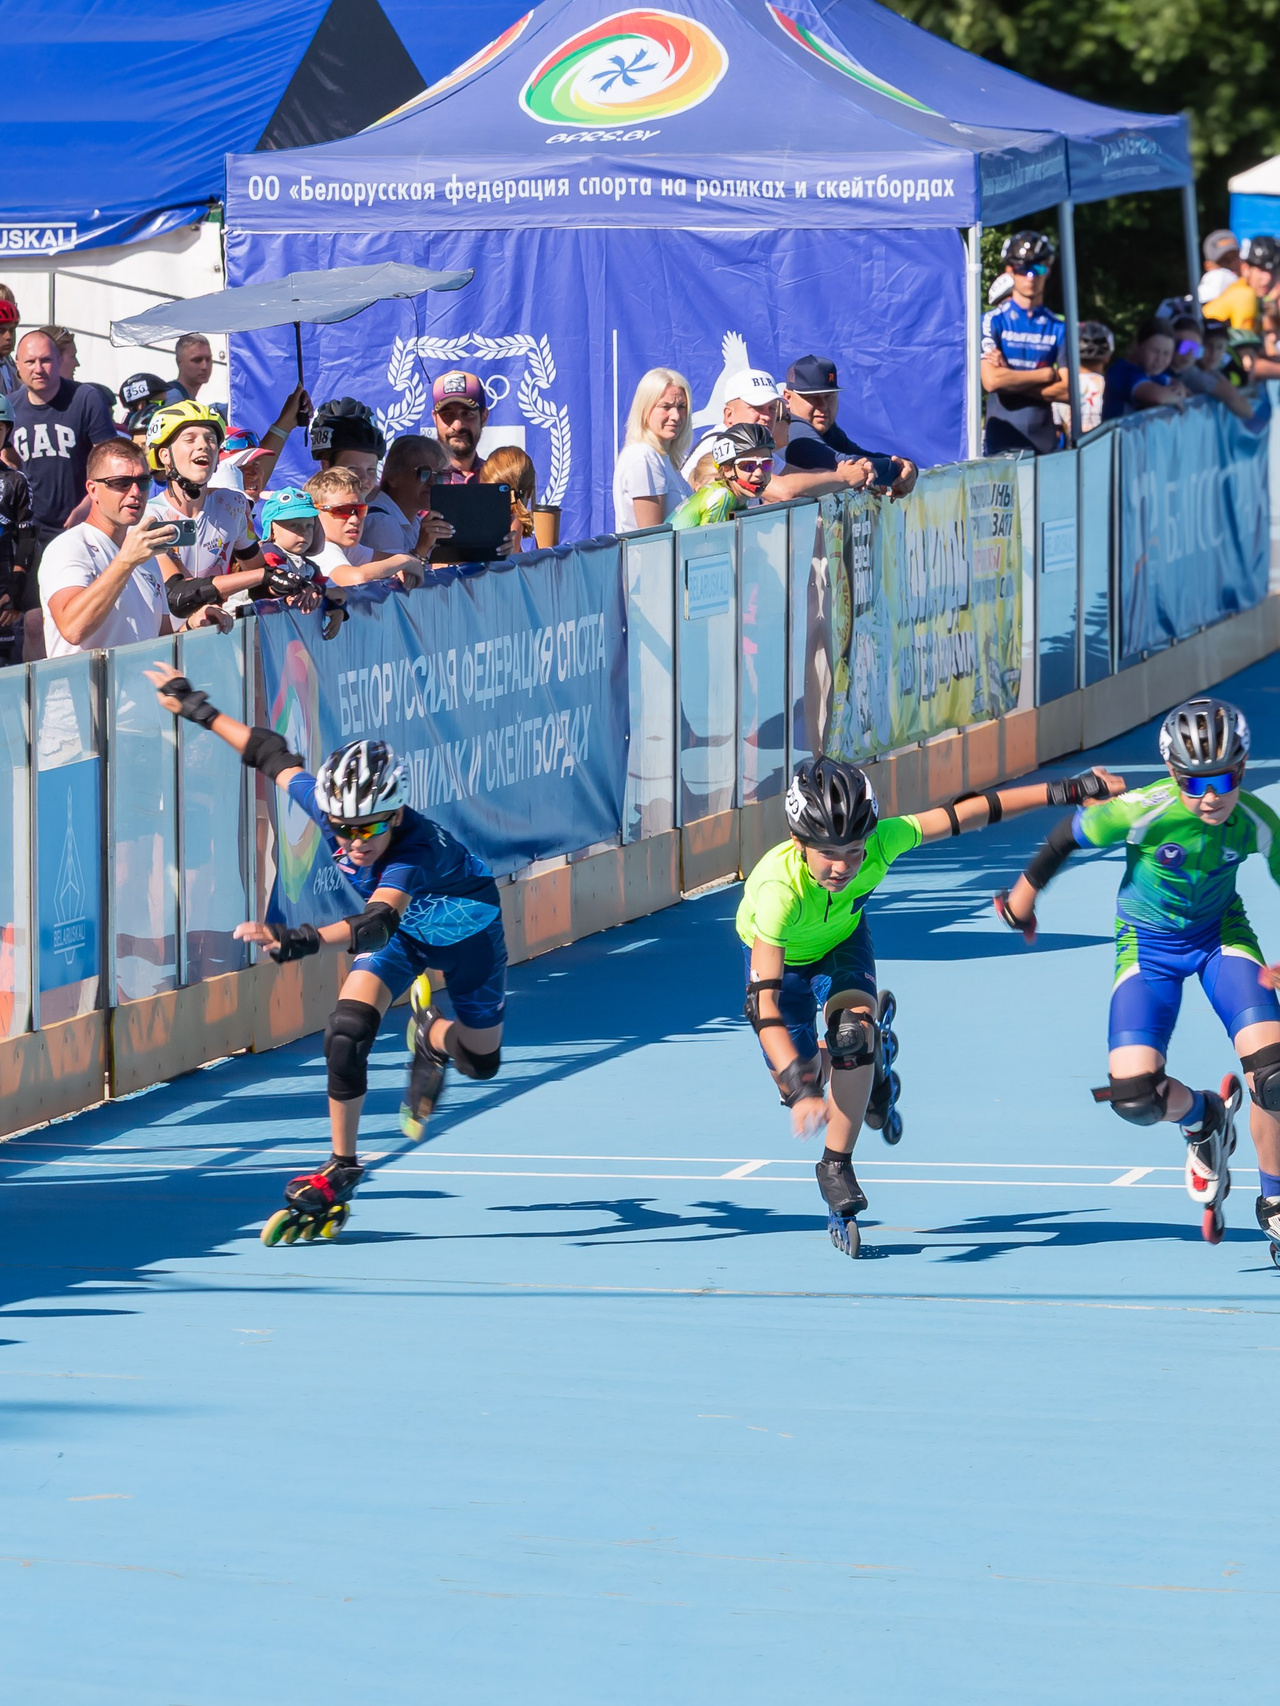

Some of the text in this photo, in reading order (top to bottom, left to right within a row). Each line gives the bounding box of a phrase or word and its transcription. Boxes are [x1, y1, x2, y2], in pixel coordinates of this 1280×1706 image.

[248, 175, 280, 201] ОО
[289, 174, 436, 207] «Белорусская
[445, 173, 570, 206] федерация
[578, 175, 652, 202] спорта
[661, 177, 687, 196] на
[696, 177, 787, 203] роликах
[795, 180, 807, 198] и
[816, 173, 955, 204] скейтбордах
[13, 422, 77, 462] GAP
